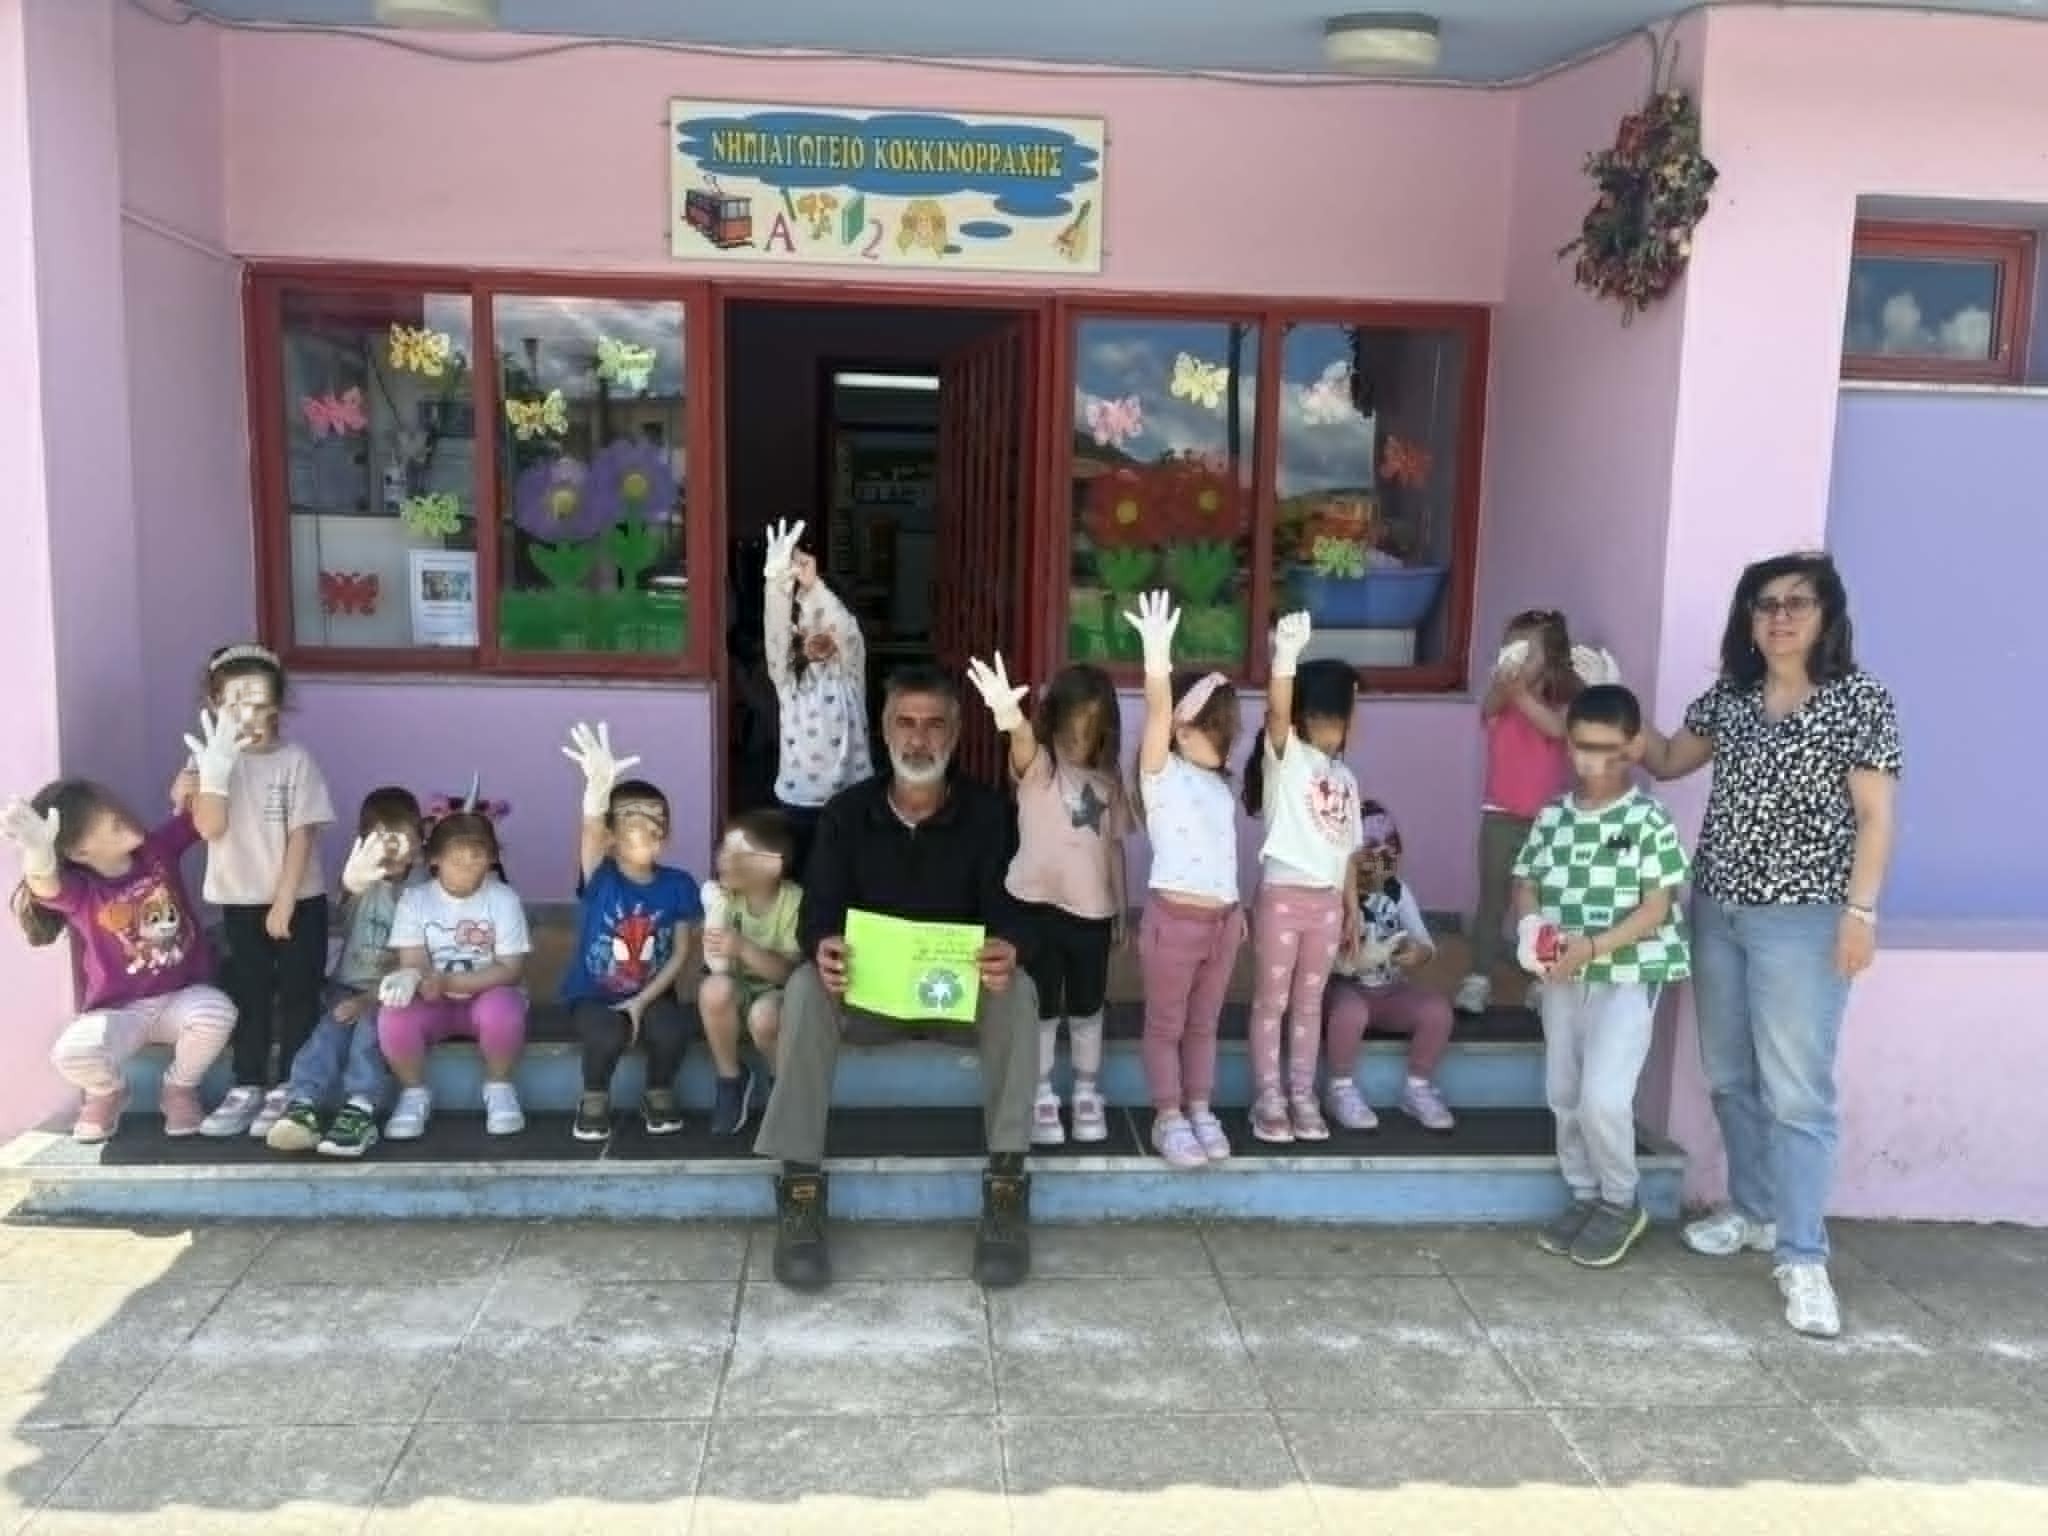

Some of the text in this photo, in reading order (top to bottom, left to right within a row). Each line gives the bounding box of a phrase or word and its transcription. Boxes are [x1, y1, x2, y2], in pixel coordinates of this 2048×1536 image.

[711, 130, 1063, 176] ΝΗΠΙΑΓΩΓΕΙΟ ΚΟΚΚΙΝΟΡΡΑΧΗΣ
[861, 217, 883, 260] 2
